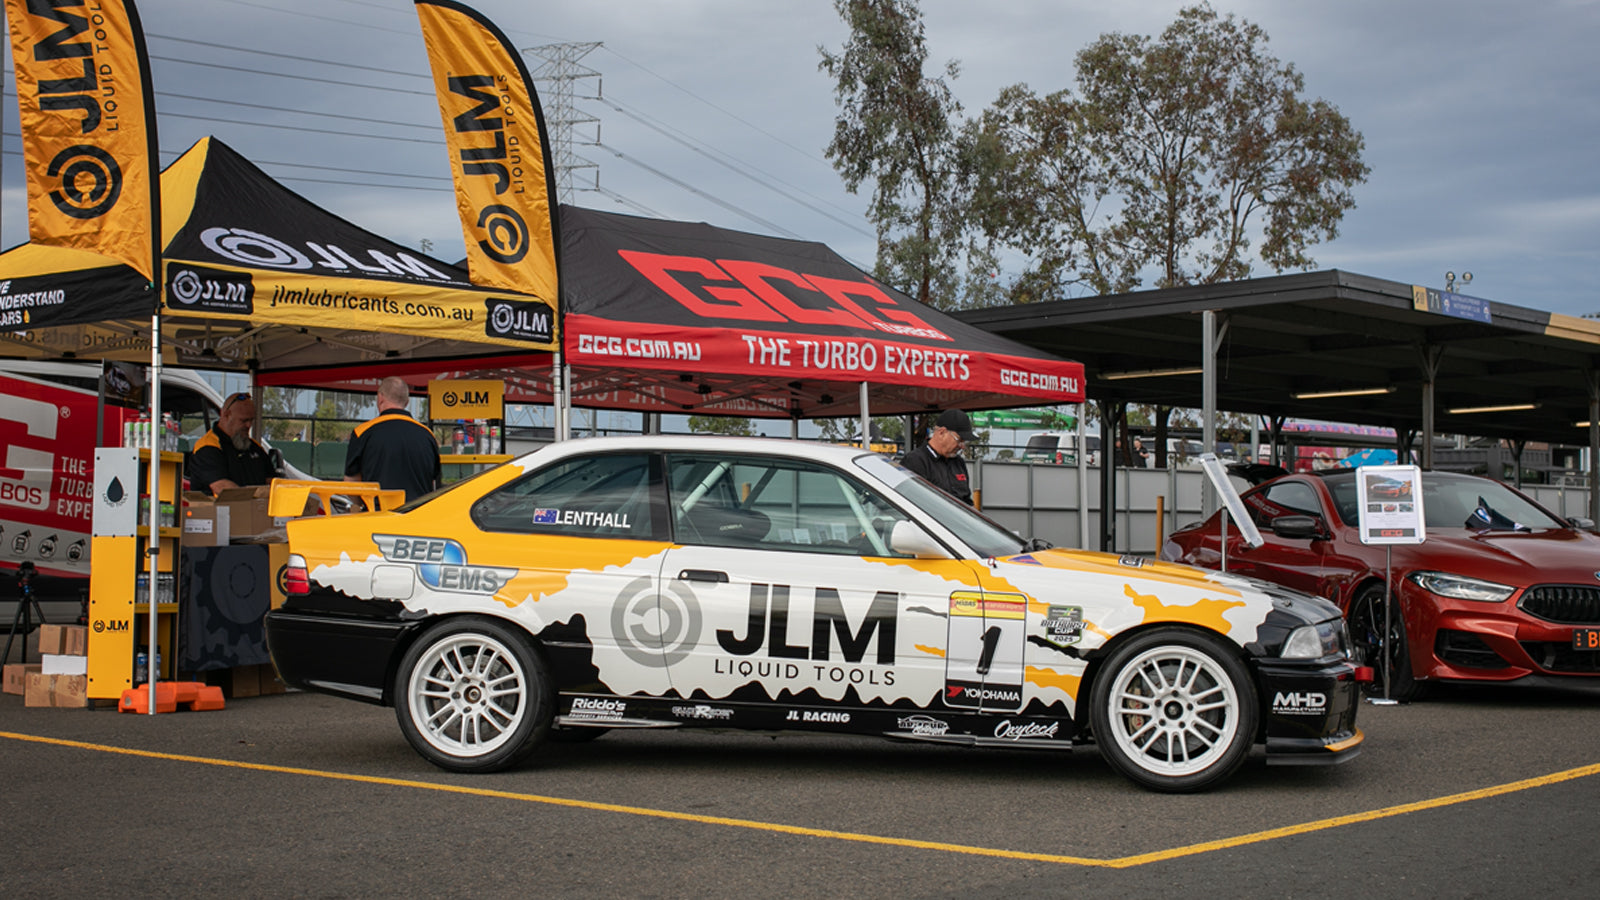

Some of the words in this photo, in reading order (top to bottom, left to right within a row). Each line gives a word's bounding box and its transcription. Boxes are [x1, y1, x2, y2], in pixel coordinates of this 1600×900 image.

[90, 0, 109, 54] TOOL
[27, 0, 102, 134] JLM
[100, 64, 119, 132] LIQUID
[497, 74, 517, 127] TOOLS
[447, 75, 511, 195] JLM
[508, 136, 525, 194] LIQUID
[305, 241, 451, 280] JLM
[0, 280, 12, 295] E
[202, 280, 247, 302] JLM
[617, 249, 956, 342] GCG
[0, 289, 65, 310] NDERSTAND
[270, 284, 474, 322] jlmlubricants.com.au
[1428, 291, 1440, 310] 71
[0, 310, 23, 326] ARS
[513, 310, 549, 333] JLM
[578, 334, 701, 361] GCG.COM.AU
[742, 335, 791, 367] THE
[797, 340, 877, 371] TURBO
[884, 345, 970, 381] EXPERTS
[1000, 368, 1078, 394] GCG.COM.AU
[460, 391, 489, 404] JLM
[61, 456, 87, 477] THE
[0, 482, 42, 505] BOS
[59, 477, 93, 499] TURB
[57, 498, 91, 520] EXPE
[555, 511, 631, 529] LENTHALL
[392, 538, 444, 563] BEE
[441, 566, 498, 592] EMS
[106, 620, 129, 630] JLM
[716, 583, 899, 666] JLM
[976, 625, 1002, 675] 1
[1588, 631, 1600, 649] B
[715, 659, 799, 679] LIQUID
[814, 666, 895, 686] TOOLS
[572, 698, 626, 711] Riddo's
[964, 688, 1020, 701] YOKOHAMA
[1272, 691, 1327, 707] MHD
[786, 710, 801, 720] JL
[802, 711, 850, 723] RACING
